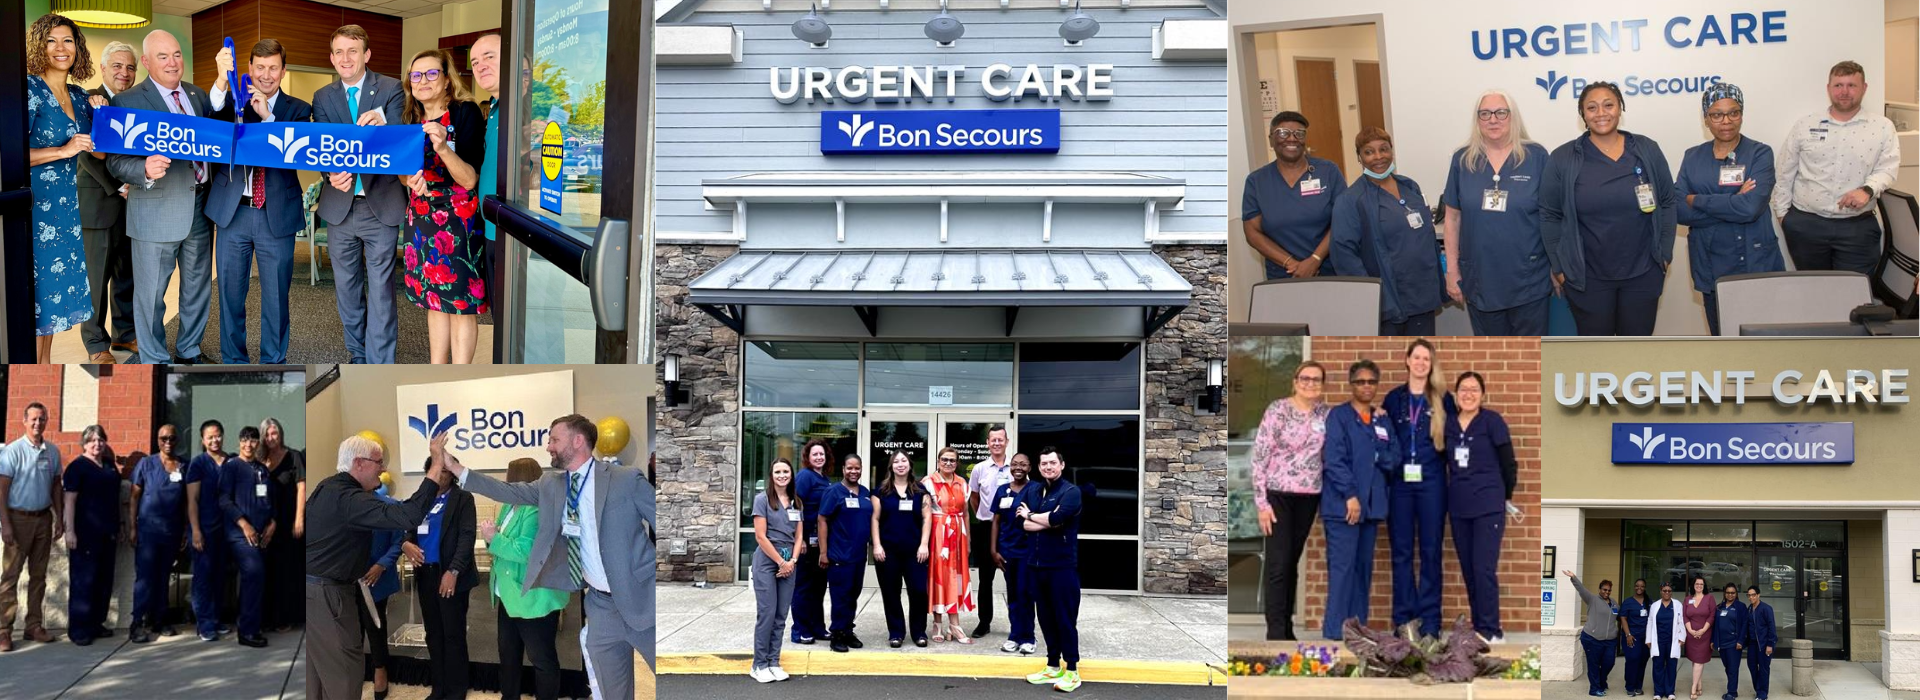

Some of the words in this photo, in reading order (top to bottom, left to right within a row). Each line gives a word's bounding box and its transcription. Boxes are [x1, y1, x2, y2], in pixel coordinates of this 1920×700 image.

[1471, 19, 1648, 60] URGENT
[1664, 10, 1787, 48] CARE
[769, 64, 965, 103] URGENT
[981, 62, 1113, 101] CARE
[156, 120, 195, 143] Bon
[878, 126, 931, 147] Bon
[936, 123, 1043, 146] Secours
[143, 134, 222, 158] Secours
[320, 134, 363, 154] Bon
[542, 145, 563, 157] CAUTION
[305, 147, 391, 168] Secours
[1554, 370, 1755, 407] URGENT
[1772, 368, 1910, 406] CARE
[471, 408, 524, 431] Bon
[454, 428, 551, 451] Secour
[1670, 436, 1722, 460] Bon
[1727, 436, 1836, 460] Secours
